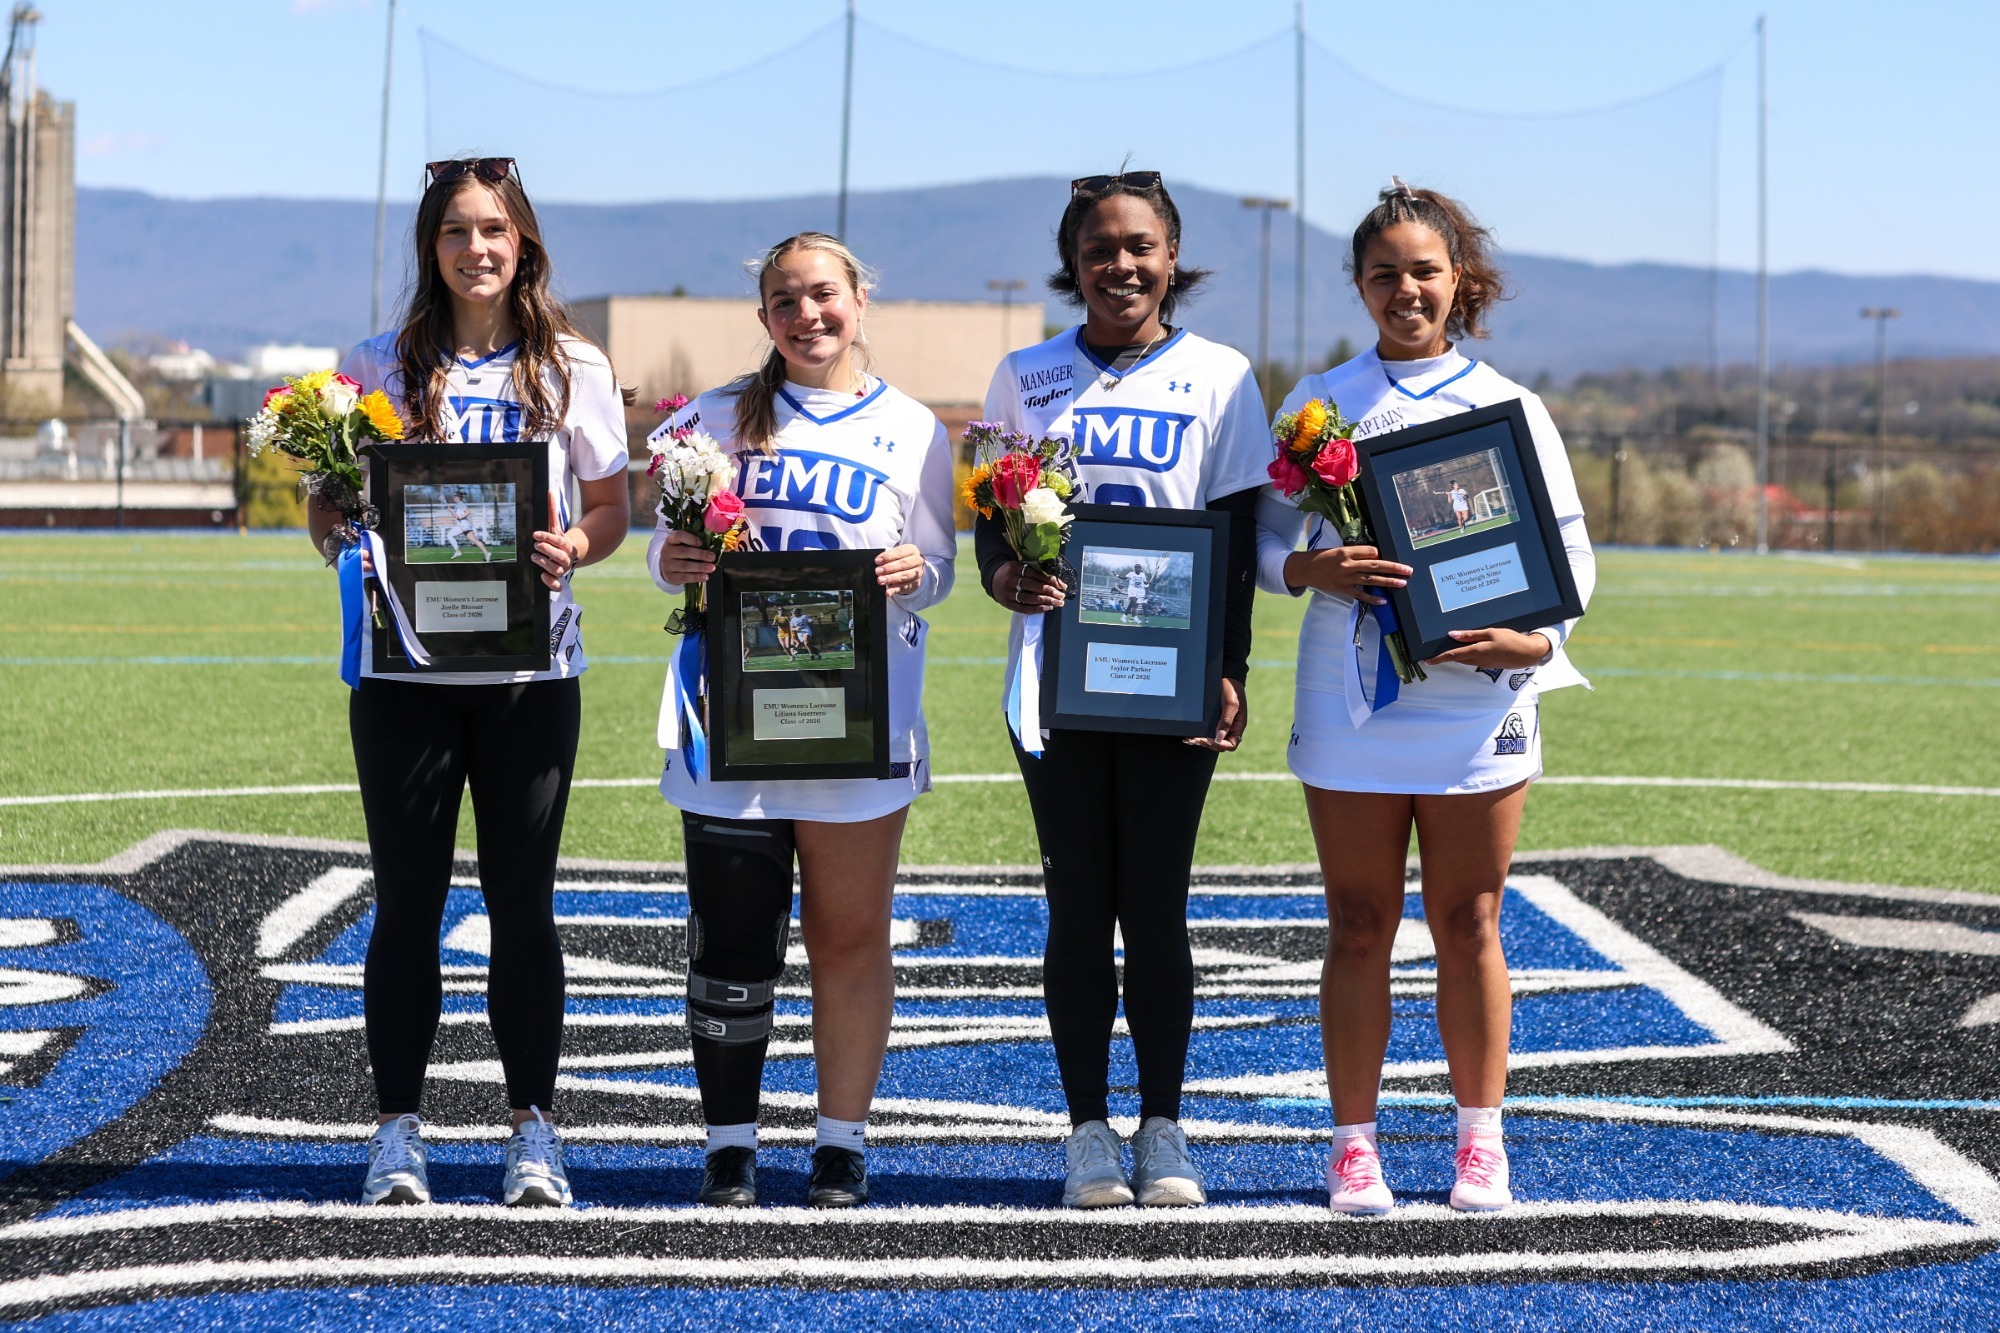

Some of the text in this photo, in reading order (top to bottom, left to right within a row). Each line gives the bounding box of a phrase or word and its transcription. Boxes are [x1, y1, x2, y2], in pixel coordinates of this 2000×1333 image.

[1020, 364, 1073, 392] MANAGER
[1024, 387, 1072, 409] Taylor
[1356, 406, 1403, 440] APTAIN
[1072, 414, 1181, 465] MU
[741, 455, 878, 516] EMU
[1441, 559, 1511, 582] EMU Women's Lacrosse
[1455, 570, 1502, 586] Shayleigh Sims
[1461, 585, 1477, 593] Class
[1111, 657, 1139, 665] Women's
[1497, 738, 1527, 754] EMU
